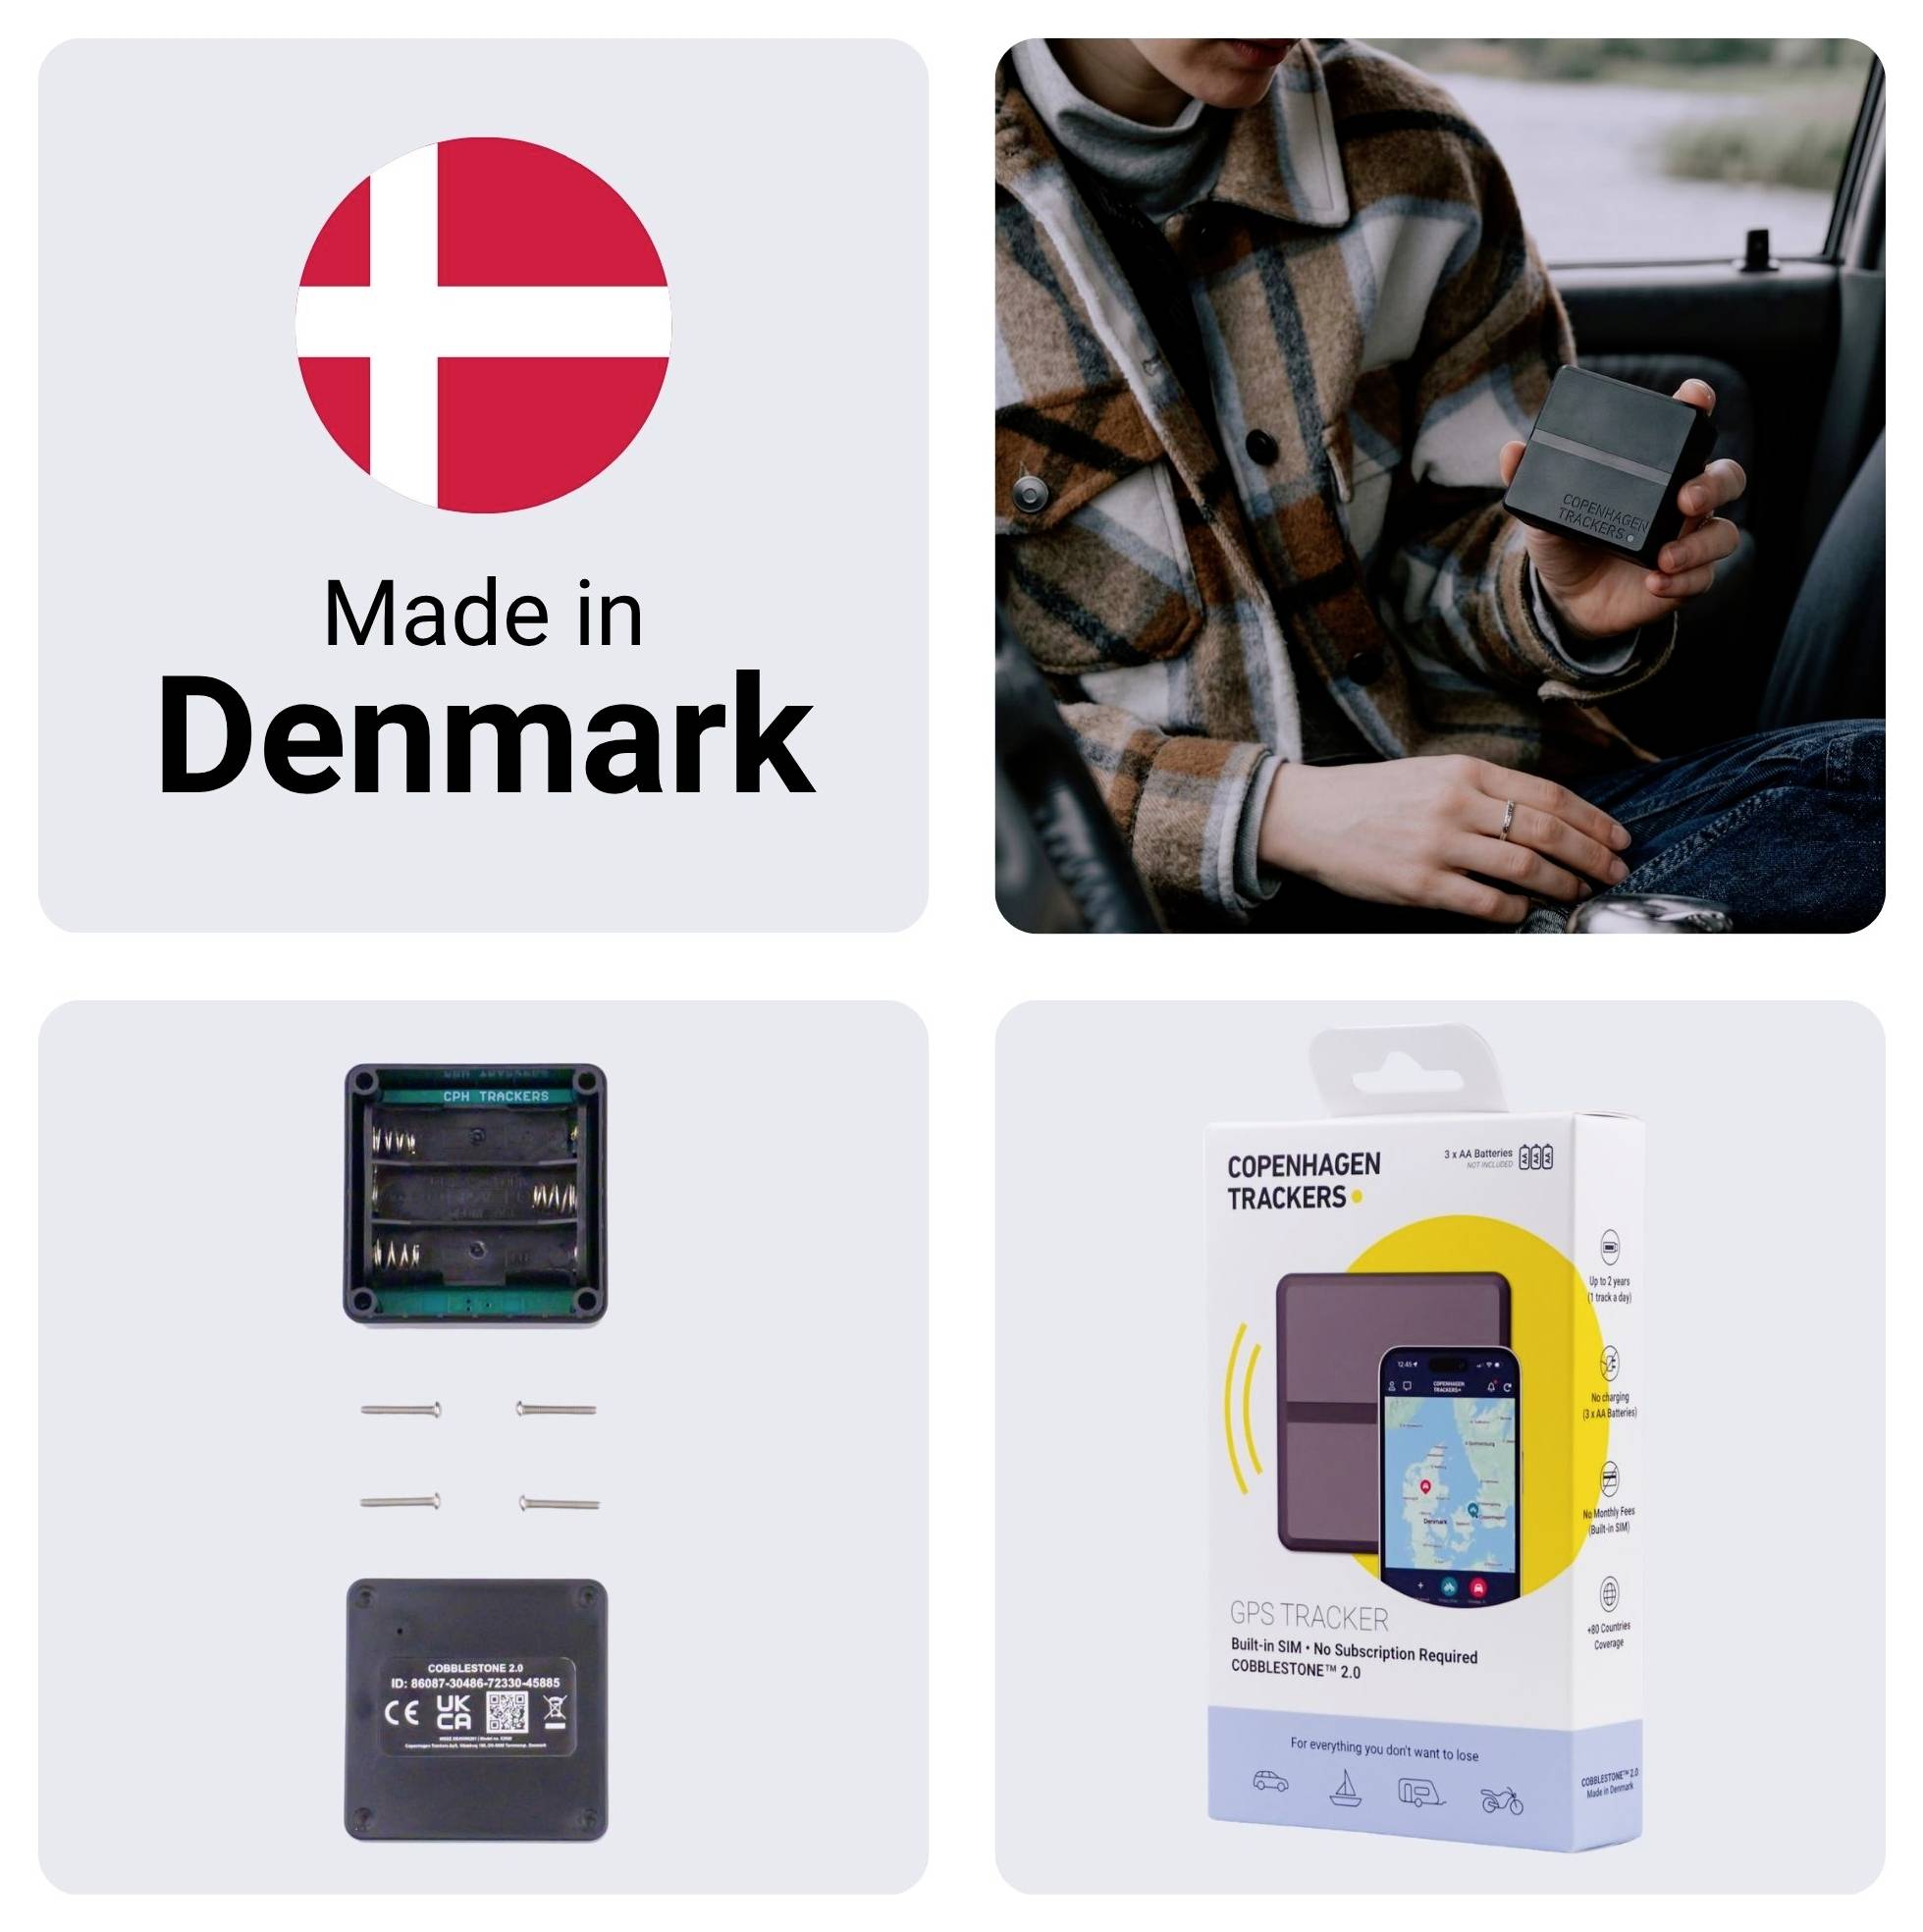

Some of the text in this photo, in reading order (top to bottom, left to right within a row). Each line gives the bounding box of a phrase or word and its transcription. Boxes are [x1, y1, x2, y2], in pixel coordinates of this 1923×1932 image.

[1563, 494, 1650, 533] COPENHAGEN
[1557, 507, 1626, 539] TRACKERS
[444, 1091, 549, 1101] CPH TRACKERS
[1444, 1150, 1450, 1158] 3
[1460, 1150, 1471, 1158] AA
[1474, 1149, 1513, 1158] Batteries
[1228, 1152, 1380, 1178] COPENHAGEN
[1227, 1185, 1347, 1209] TRACKERS
[1589, 1275, 1630, 1288] Up to 2 years
[1587, 1292, 1593, 1304] (1
[1595, 1292, 1612, 1302] track
[1619, 1291, 1631, 1304] day)
[1591, 1392, 1629, 1404] No charging
[1583, 1409, 1589, 1422] (3
[1596, 1409, 1606, 1418] AA
[1607, 1407, 1637, 1420] Batteries)
[1583, 1506, 1635, 1520] No Monthly Fees
[1588, 1521, 1630, 1536] (Built-in SIM)
[1230, 1600, 1389, 1632] GPS TRACKER
[1587, 1621, 1630, 1635] +80 Countries
[1231, 1637, 1478, 1665] Built-in SIM No Subscription Required
[1594, 1638, 1625, 1650] Coverage
[428, 1664, 523, 1673] COBBLESTONE 2.0
[1341, 1665, 1361, 1679] 2.0
[392, 1678, 561, 1689] ID: 86087-30486-72330-45885
[437, 1694, 471, 1712] UK
[385, 1700, 419, 1726] CE
[437, 1713, 471, 1730] CA
[1291, 1737, 1479, 1762] For everything you don't want to lose
[1629, 1767, 1639, 1778] 2.0
[1586, 1788, 1602, 1798] Made
[1610, 1782, 1633, 1794] Denmark
